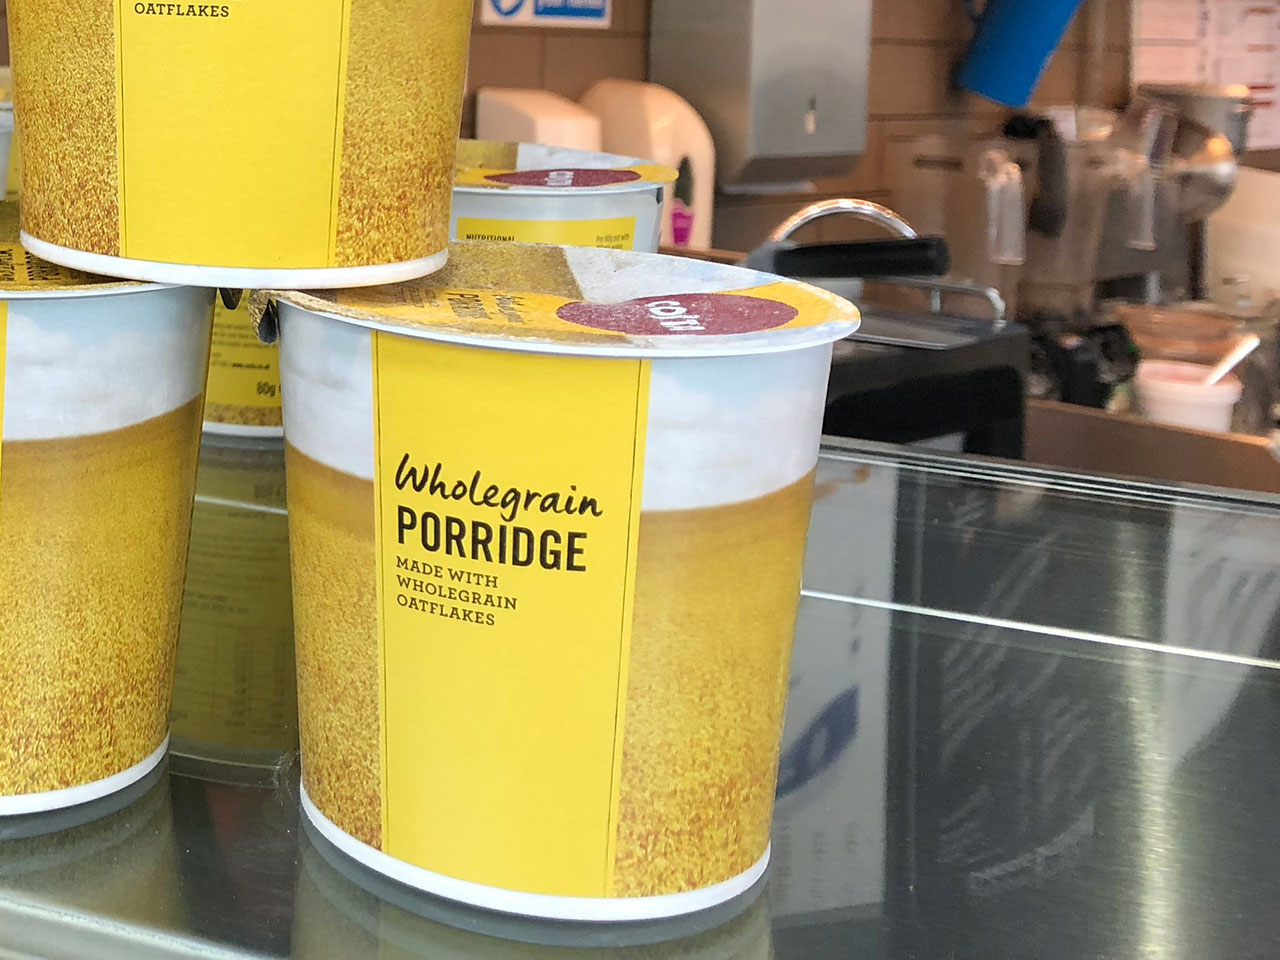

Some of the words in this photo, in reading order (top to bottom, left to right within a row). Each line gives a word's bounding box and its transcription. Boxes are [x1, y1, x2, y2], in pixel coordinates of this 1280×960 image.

[134, 2, 229, 18] OATFLAKES
[646, 300, 706, 331] COSTA
[395, 452, 603, 523] Wholegrain
[397, 504, 588, 572] PORRIDGE
[396, 555, 443, 579] MADE
[447, 568, 498, 589] WITH
[396, 574, 517, 610] WHOLEGRAIN
[396, 593, 495, 626] OATFLAKES
